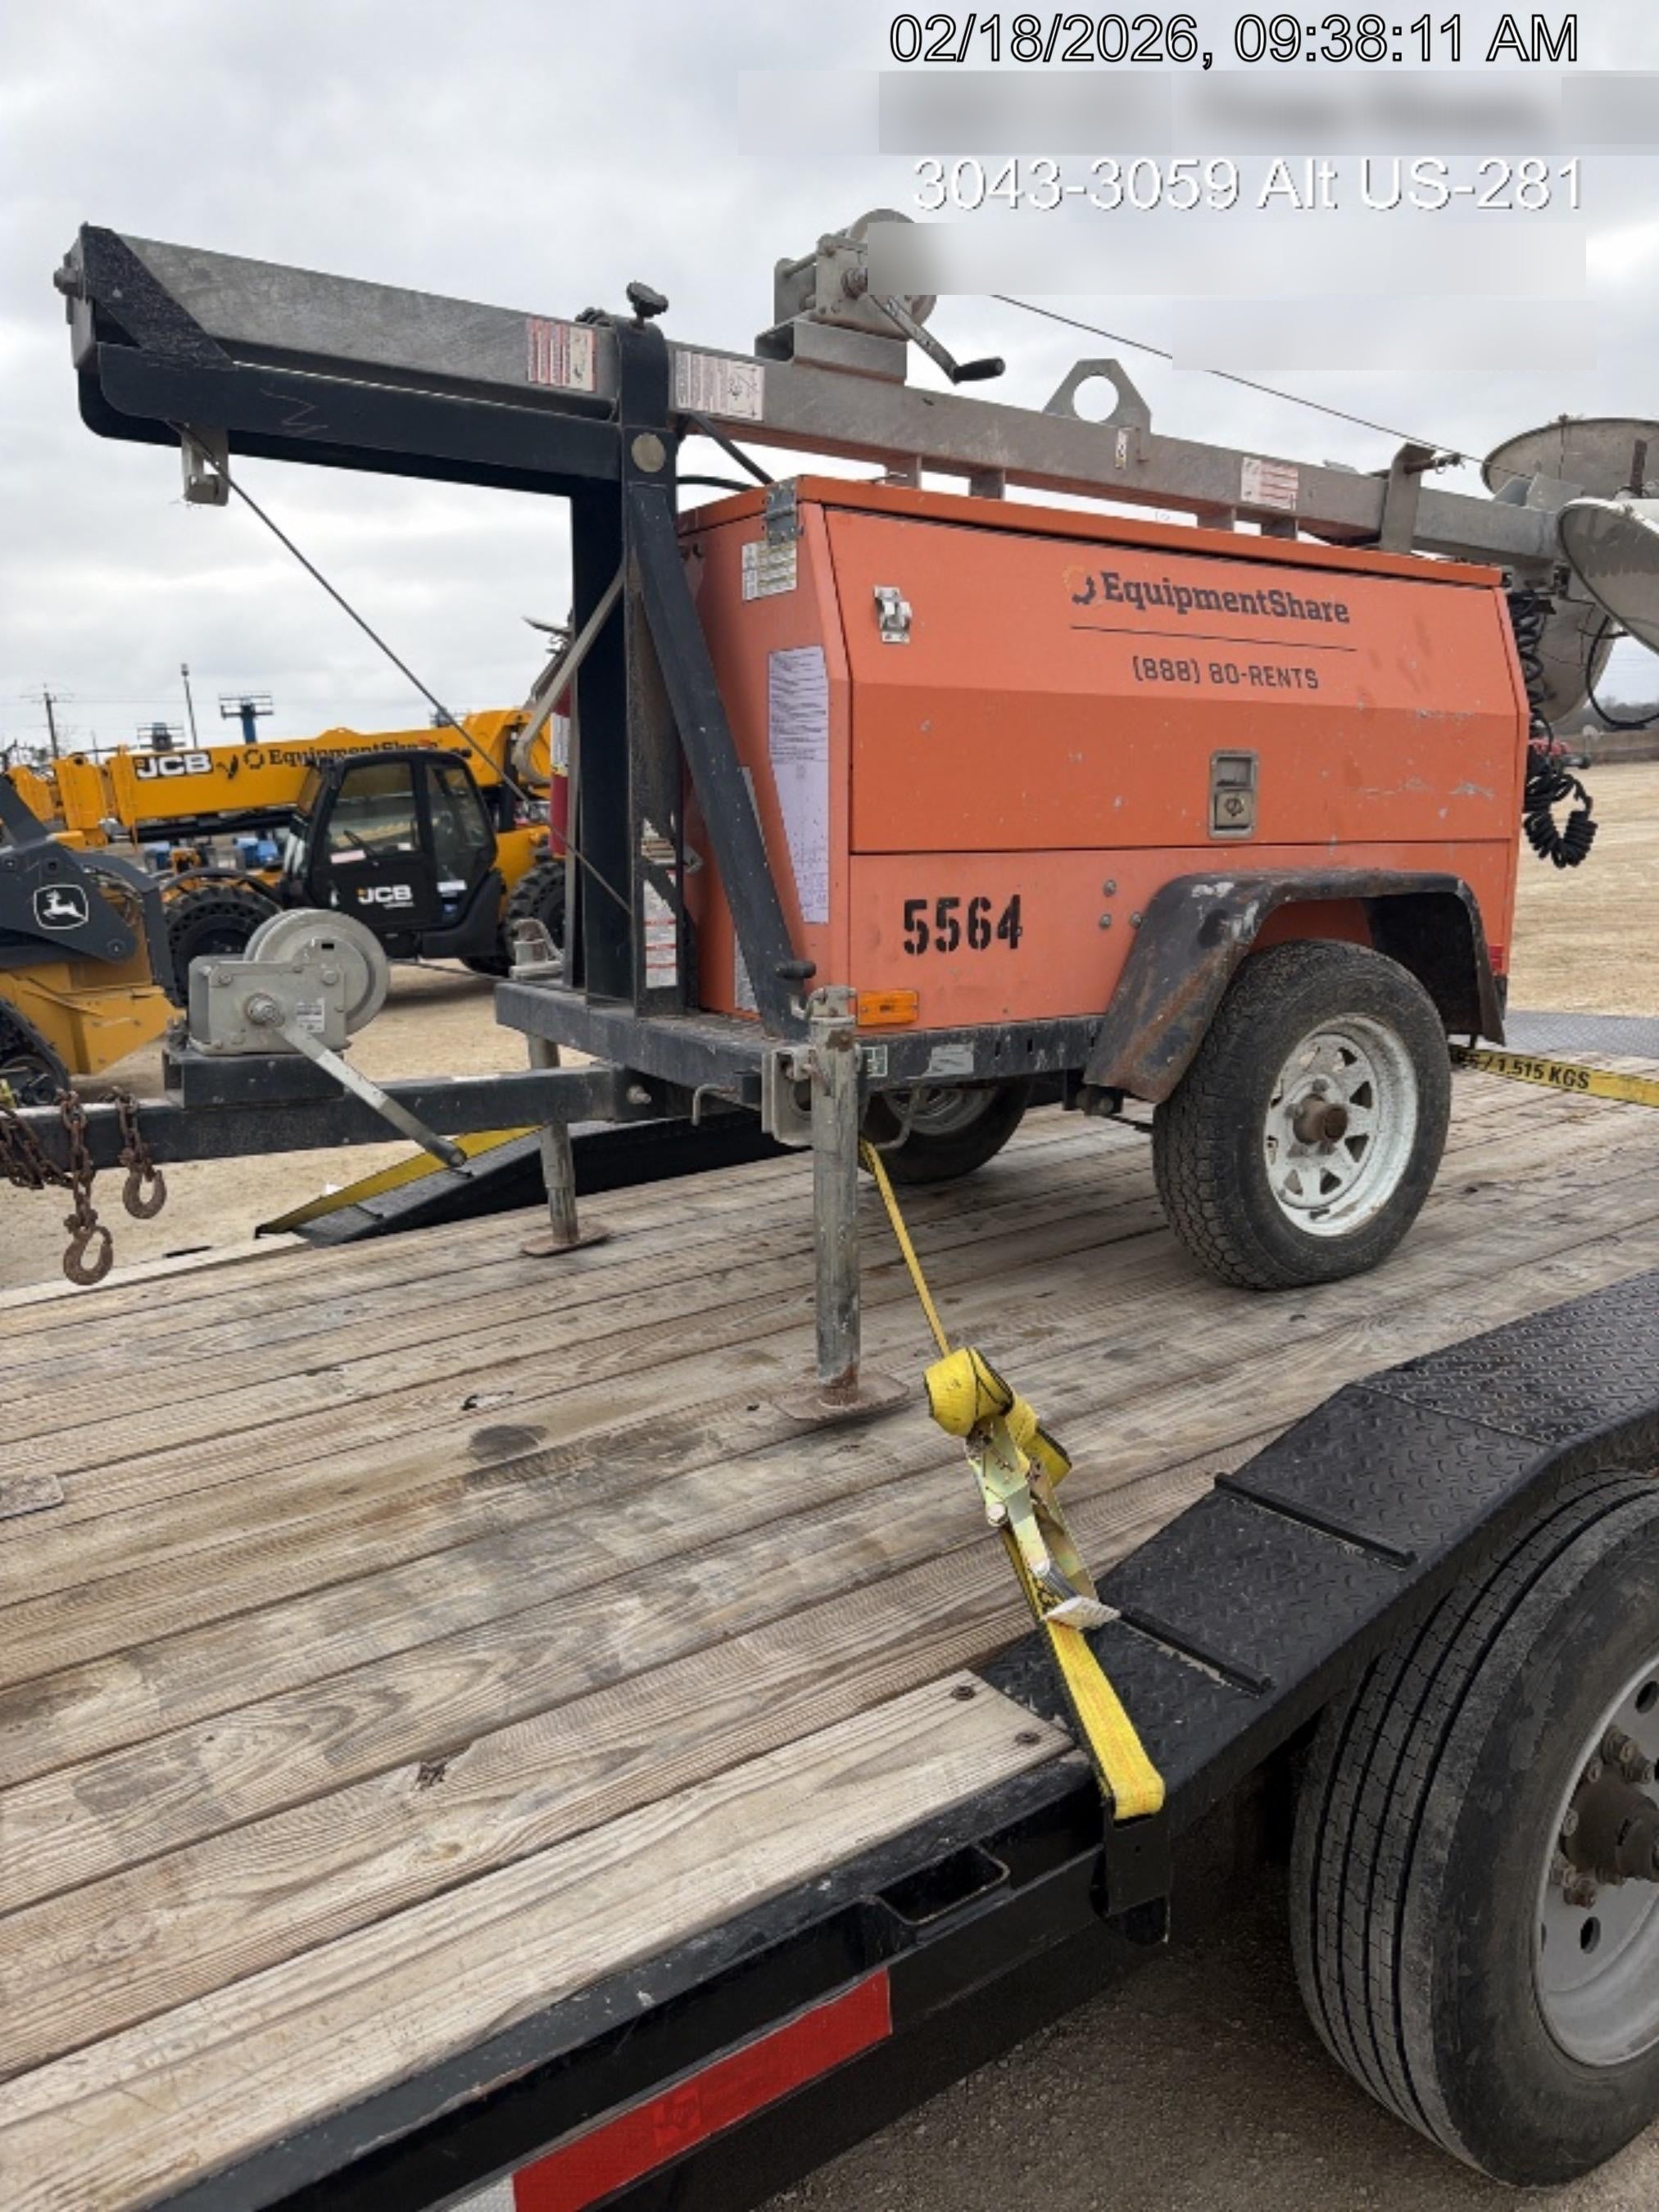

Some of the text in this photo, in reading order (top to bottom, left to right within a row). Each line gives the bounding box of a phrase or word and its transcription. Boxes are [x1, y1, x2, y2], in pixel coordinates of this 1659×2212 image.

[1100, 571, 1350, 623] EquipmentShare
[1132, 655, 1319, 690] (888) 80-RENTS
[135, 752, 212, 779] JCB
[356, 884, 413, 904] JCB
[904, 893, 1022, 957] 5564
[1548, 1066, 1591, 1090] KGS
